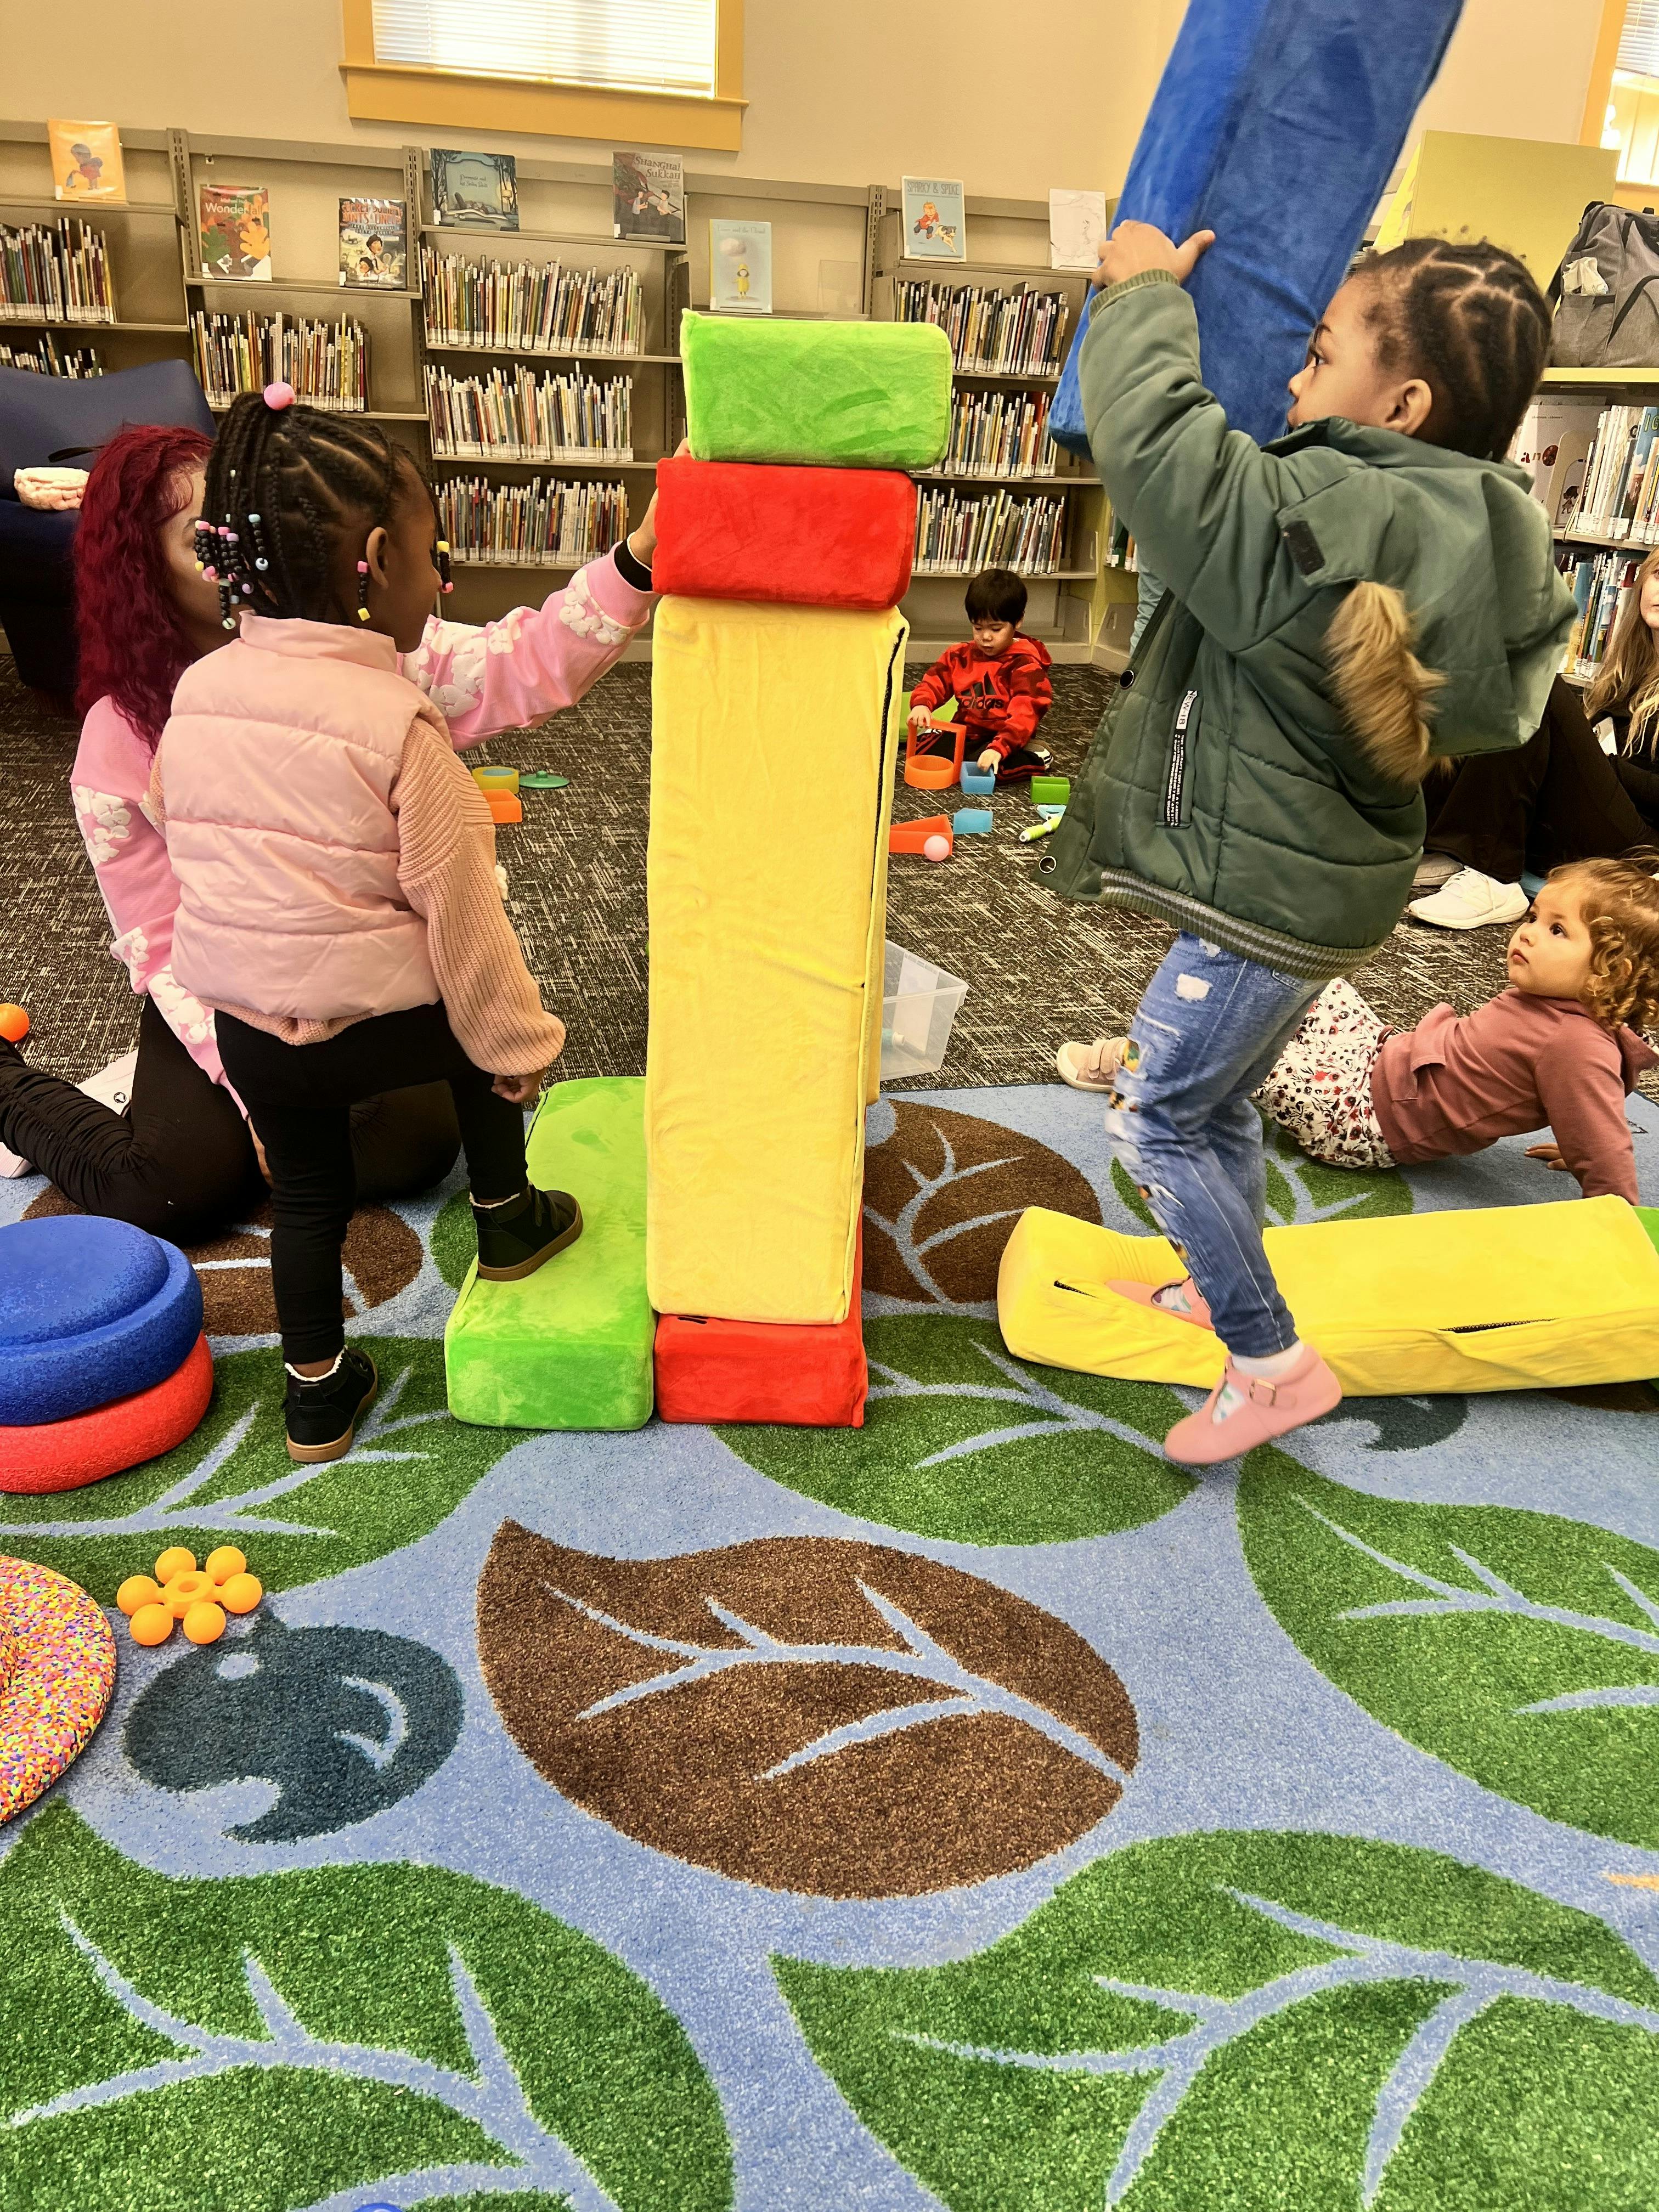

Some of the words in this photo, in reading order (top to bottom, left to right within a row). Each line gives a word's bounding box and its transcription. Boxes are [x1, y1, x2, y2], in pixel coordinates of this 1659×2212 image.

[907, 182, 931, 194] SPARKY
[933, 183, 939, 193] &
[941, 184, 960, 195] SPIKE
